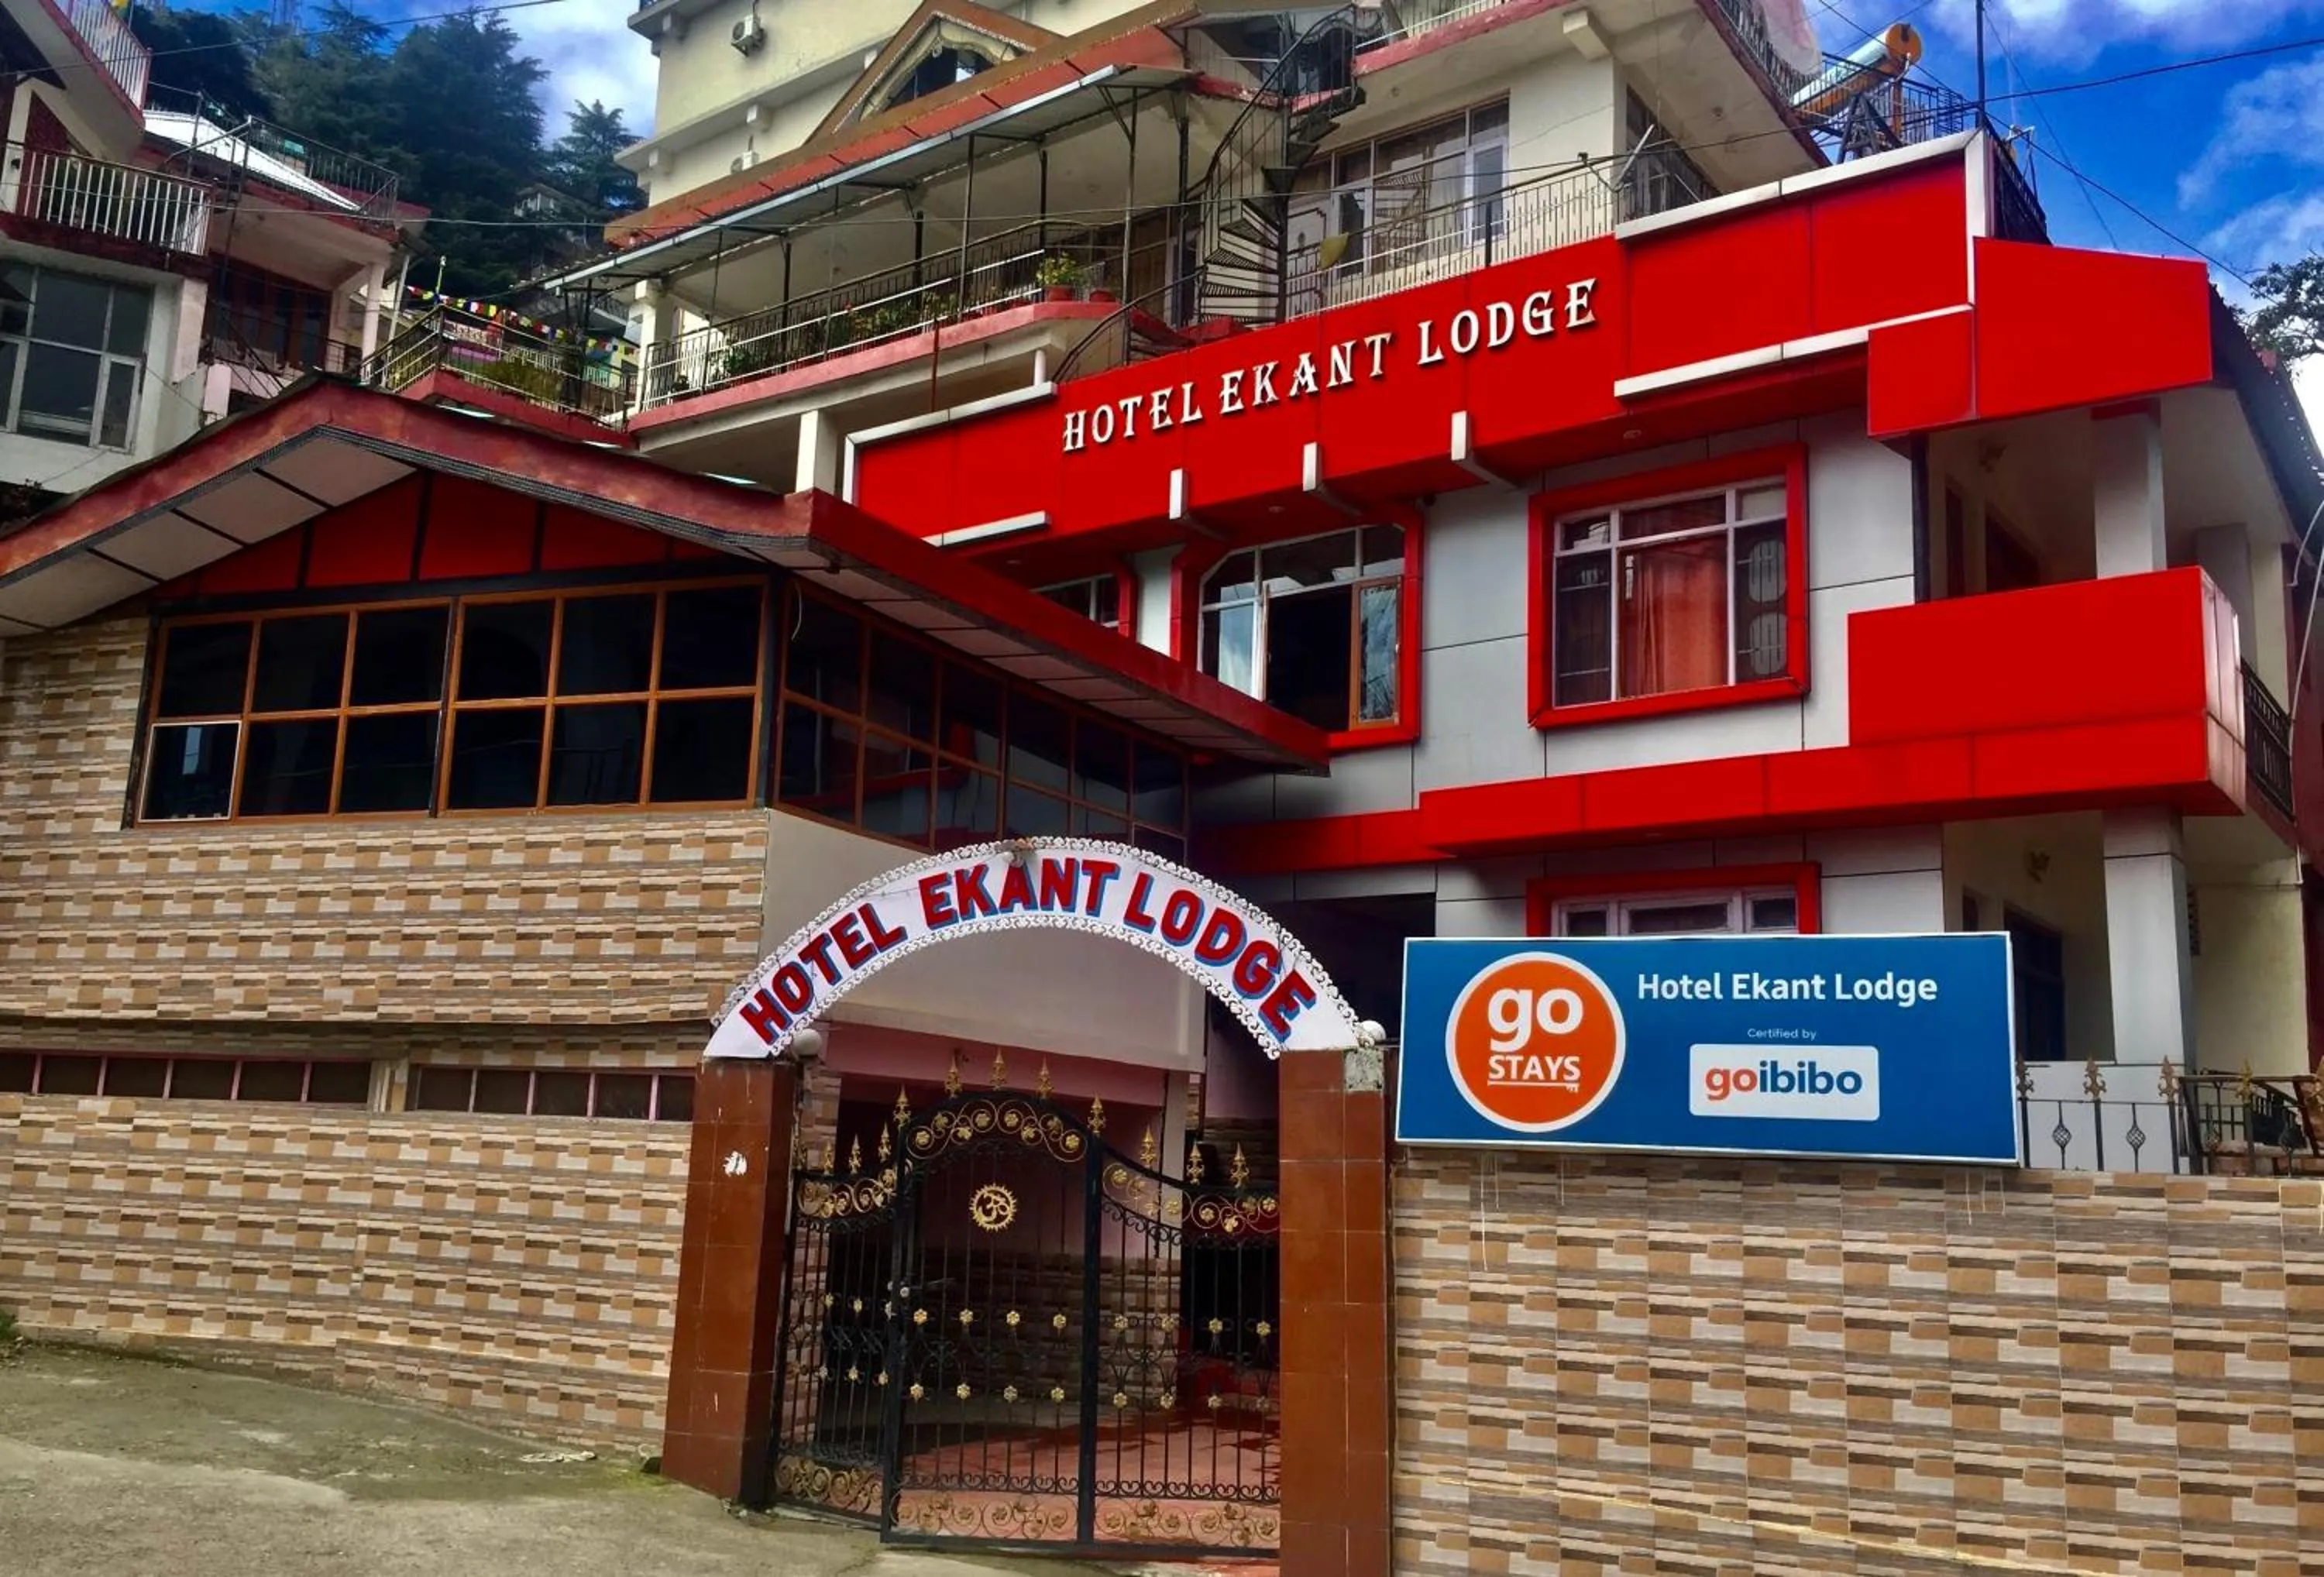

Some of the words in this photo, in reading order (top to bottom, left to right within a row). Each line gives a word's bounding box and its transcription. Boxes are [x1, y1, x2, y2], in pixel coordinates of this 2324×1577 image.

[1062, 381, 1204, 452] HOTEL
[1219, 332, 1394, 417] EKANT
[1417, 277, 1597, 366] LODGE
[739, 902, 909, 1046] HOTEL
[919, 856, 1120, 930] EKANT
[1124, 871, 1318, 1044] LODGE
[1638, 972, 1724, 1001] Hotel
[1733, 971, 1827, 1001] Ekant
[1834, 971, 1937, 1008] Lodge
[1487, 988, 1584, 1052] go
[1747, 1028, 1800, 1039] Certified
[1802, 1028, 1817, 1041] by
[1488, 1055, 1581, 1081] STAYS
[1704, 1060, 1864, 1101] goibibo
